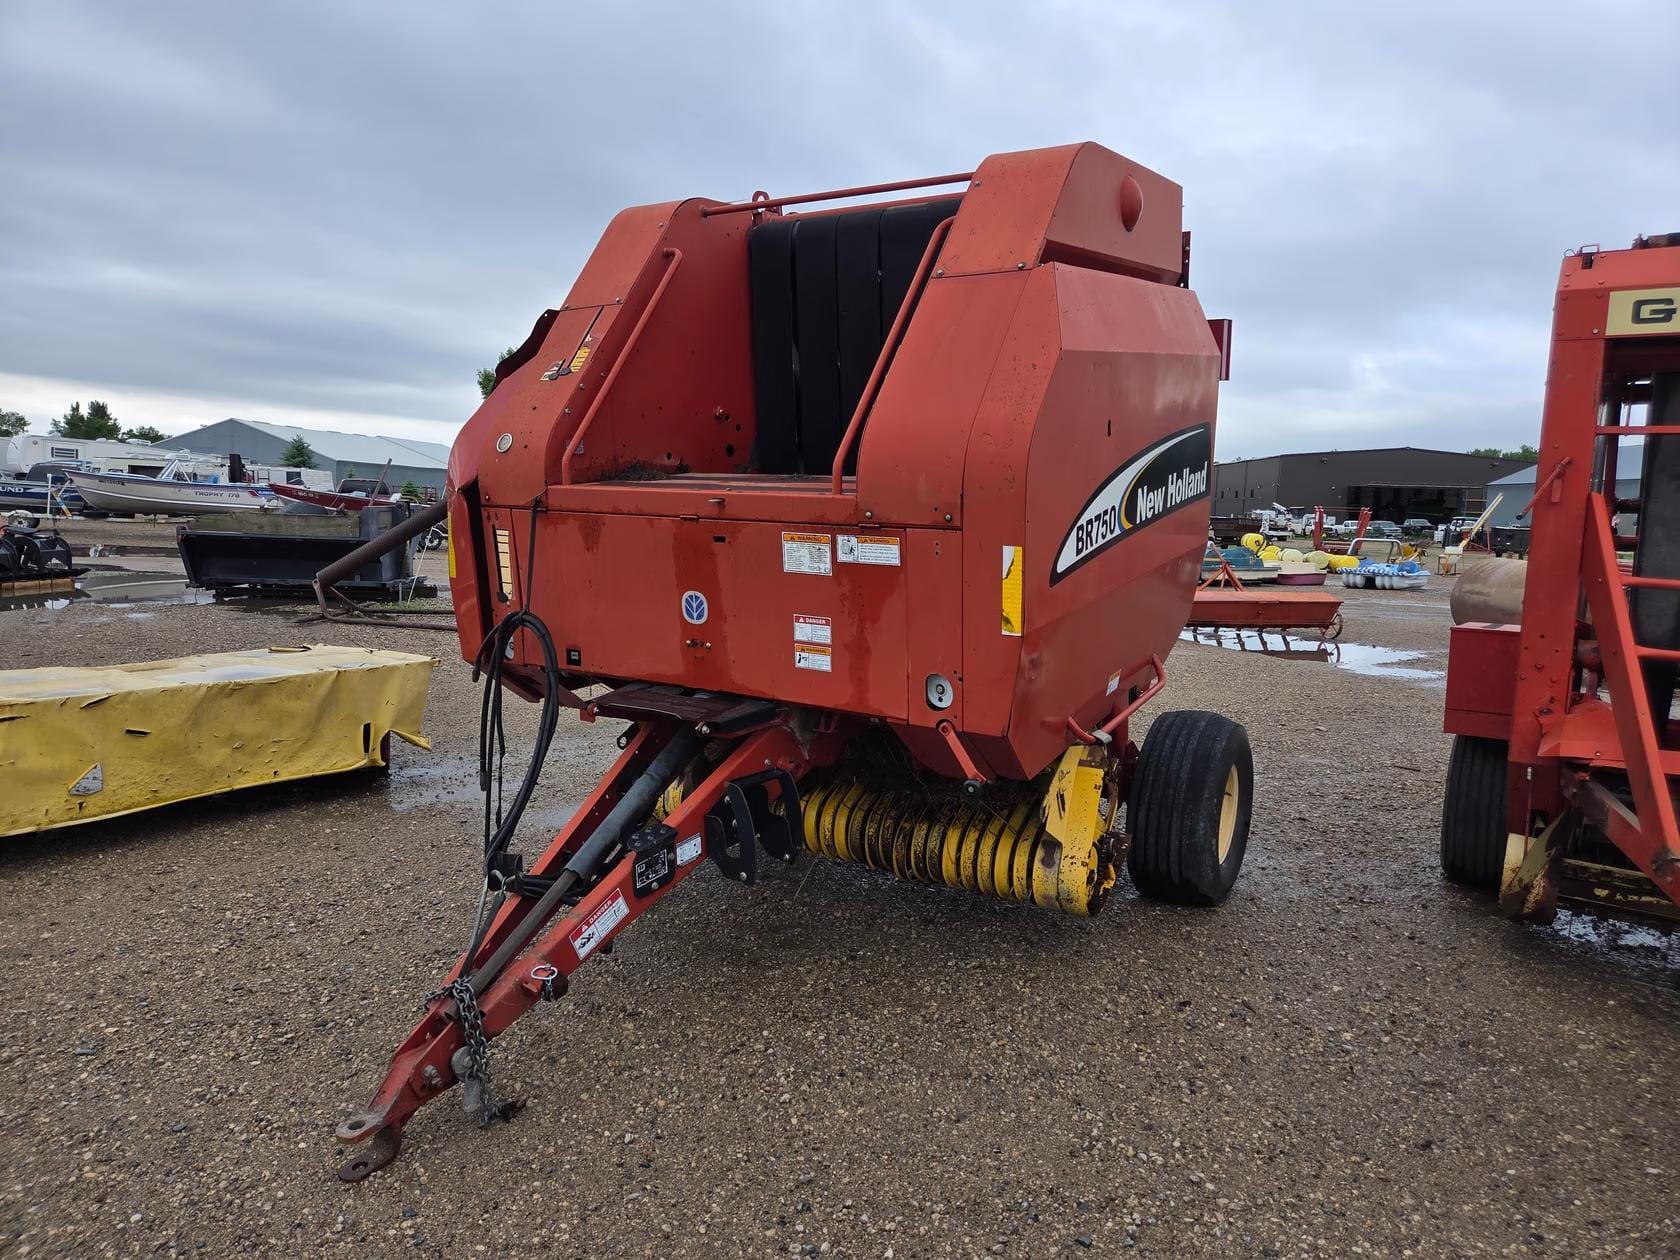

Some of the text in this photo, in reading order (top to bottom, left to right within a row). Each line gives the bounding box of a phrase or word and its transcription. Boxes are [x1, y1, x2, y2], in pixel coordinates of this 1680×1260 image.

[1136, 461, 1208, 524] New Holland
[797, 535, 823, 543] WARNING
[1076, 505, 1117, 557] BR750
[805, 617, 826, 625] DANGER
[589, 899, 612, 924] DANGER
